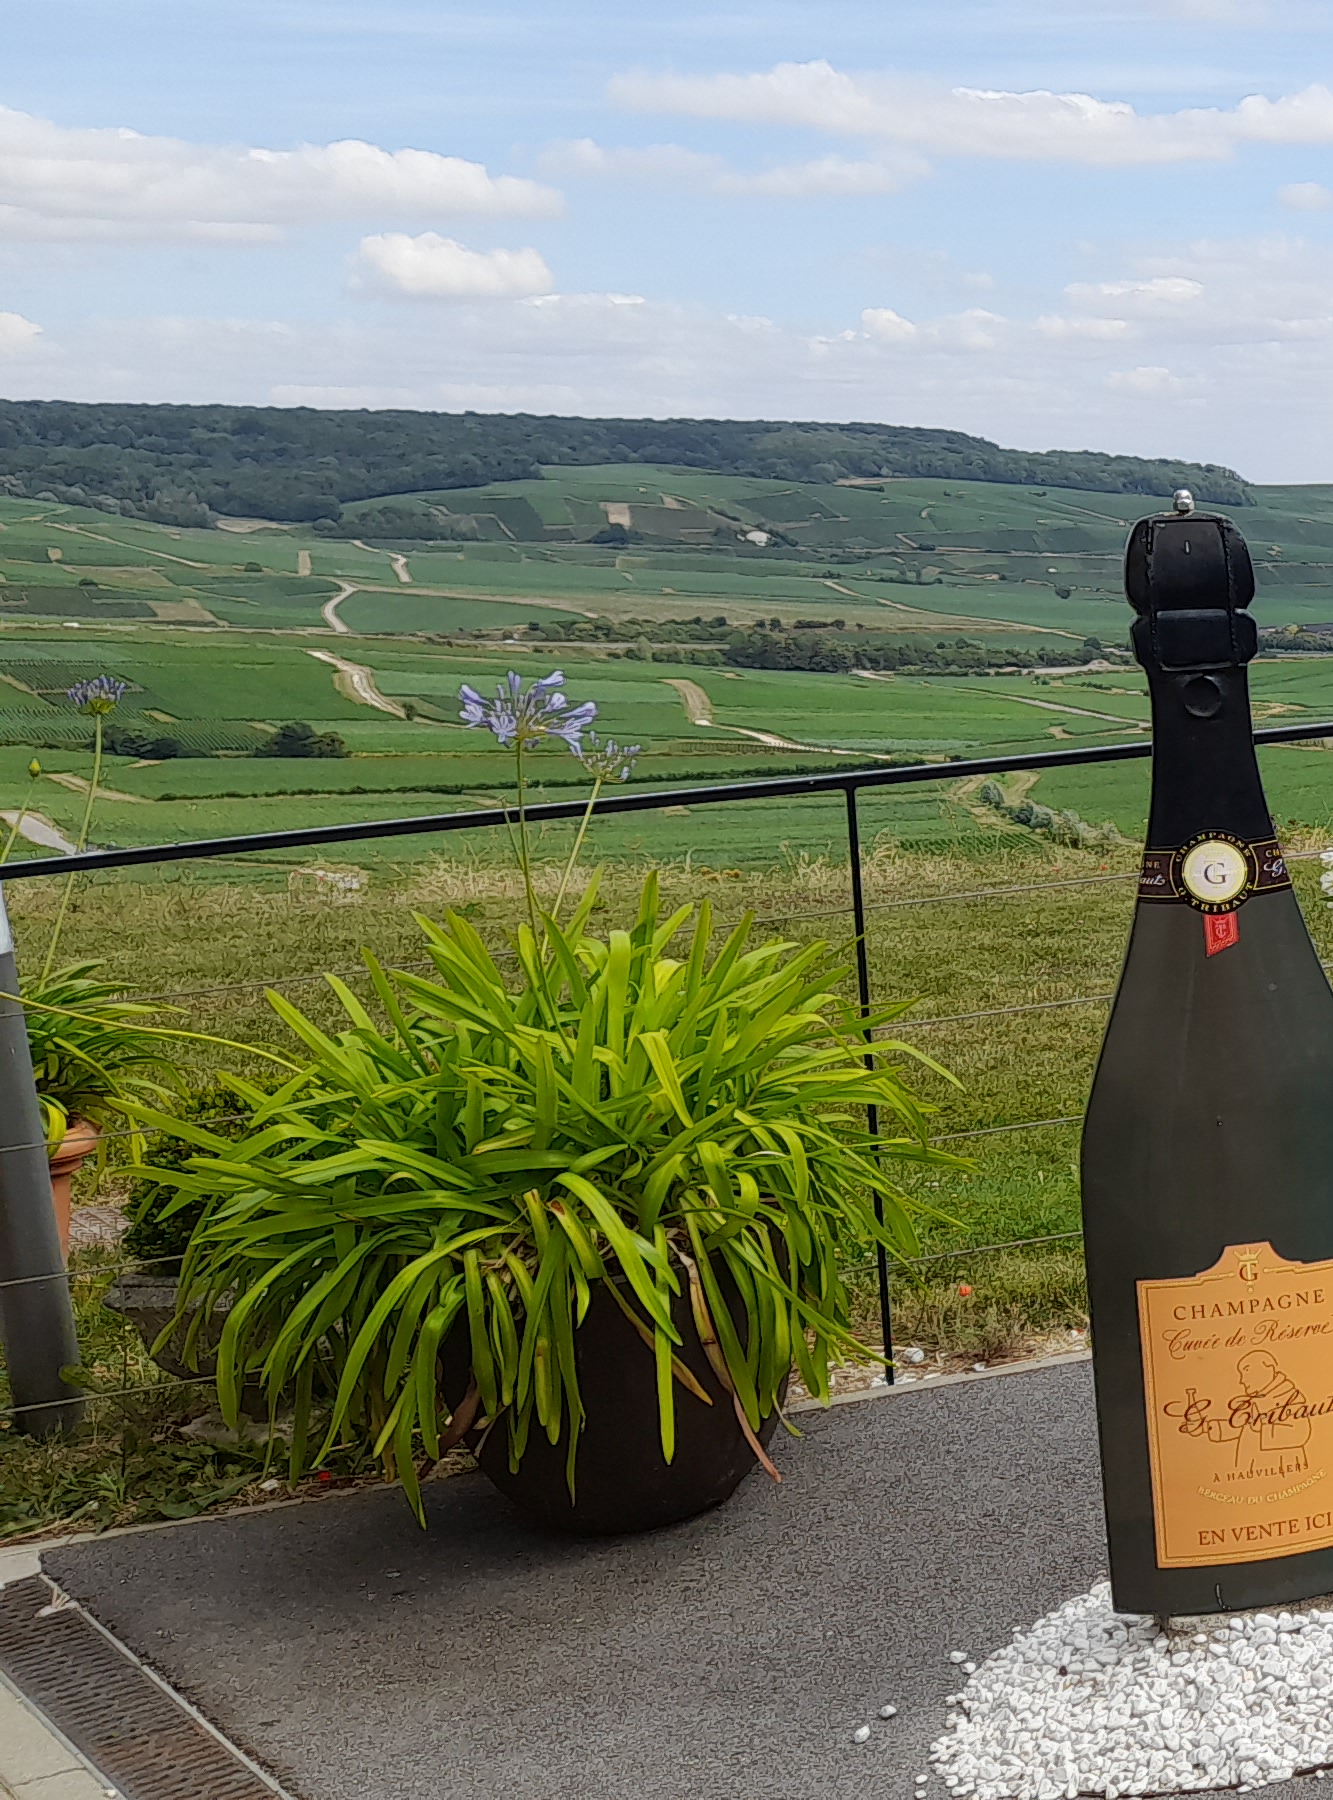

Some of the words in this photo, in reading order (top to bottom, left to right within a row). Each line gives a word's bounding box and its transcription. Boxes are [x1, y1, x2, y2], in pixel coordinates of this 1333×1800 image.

[1173, 1288, 1326, 1321] CHAMPAGNE
[1161, 1328, 1222, 1360] Cuvée
[1224, 1327, 1247, 1348] de
[1197, 1528, 1226, 1546] EN
[1231, 1518, 1300, 1543] VENTE
[1304, 1511, 1332, 1531] ICI
